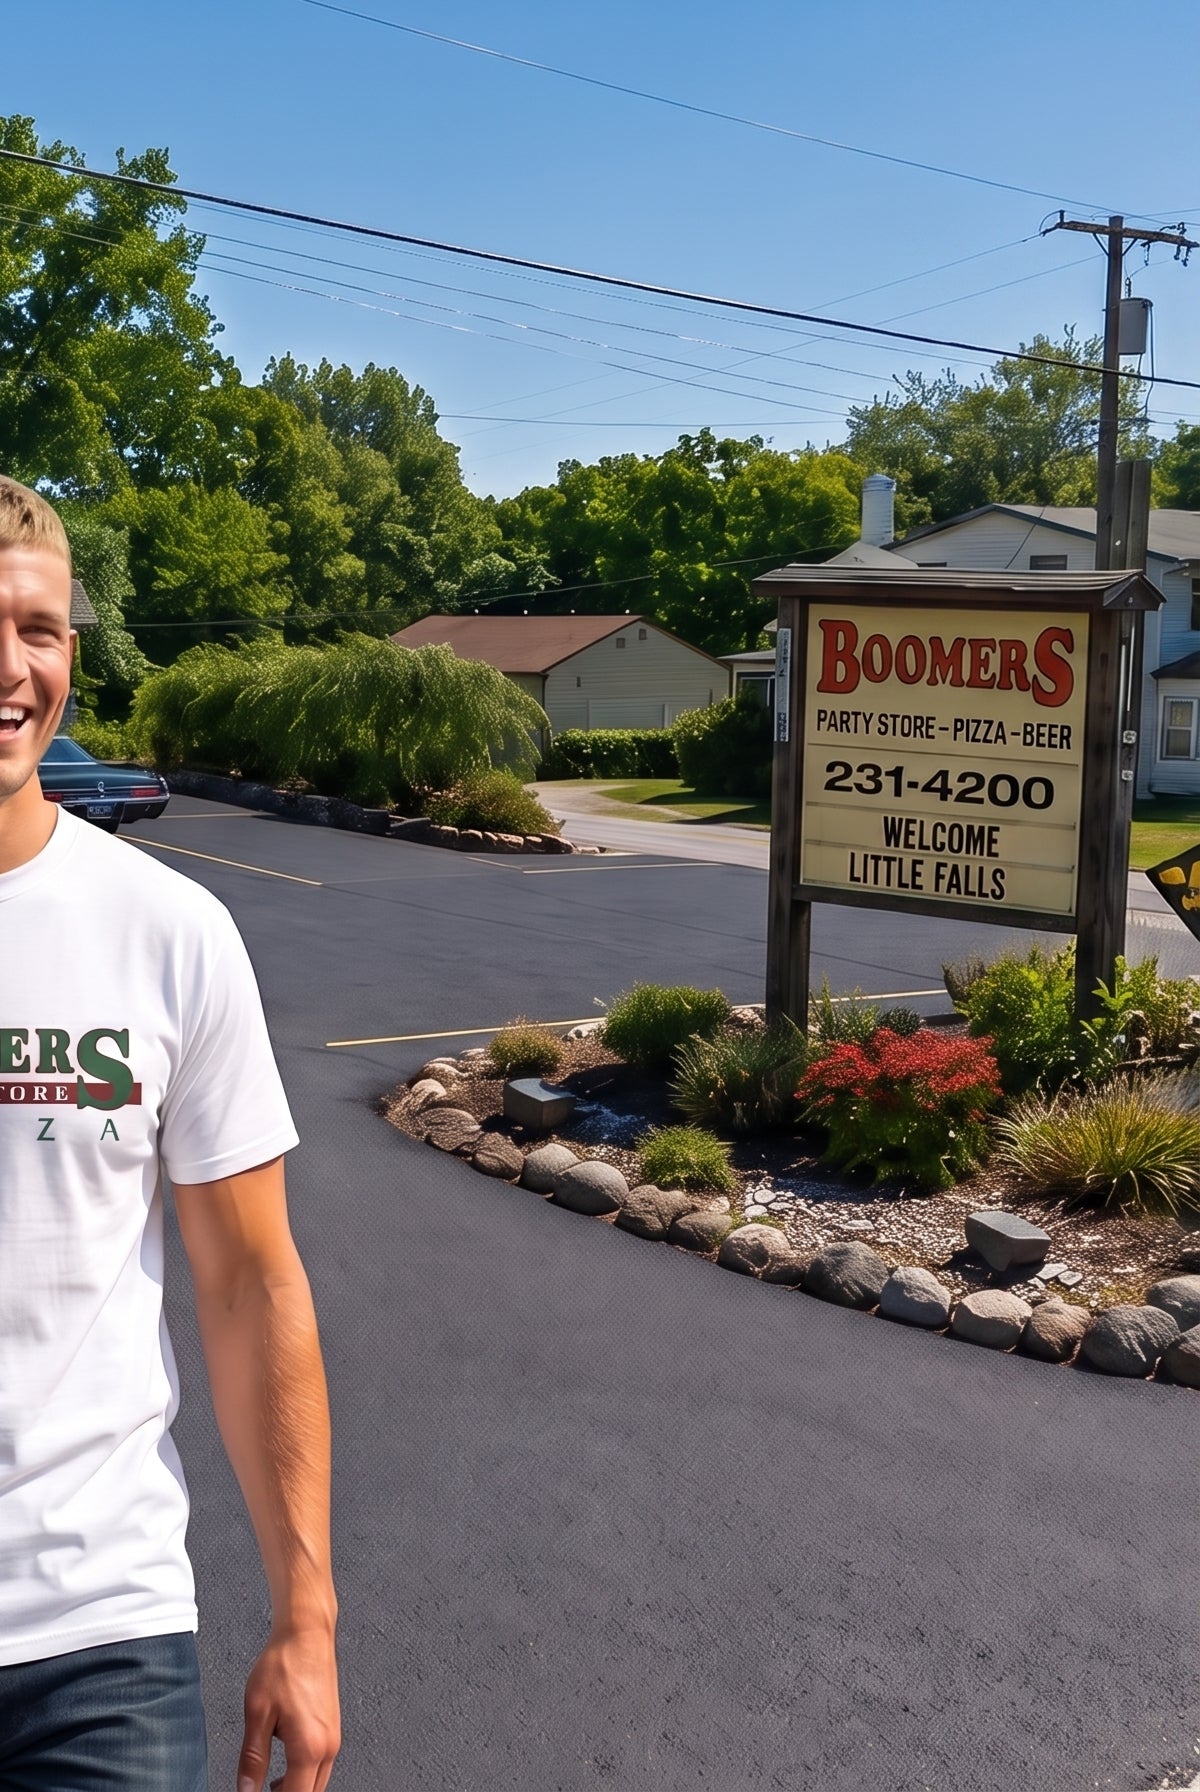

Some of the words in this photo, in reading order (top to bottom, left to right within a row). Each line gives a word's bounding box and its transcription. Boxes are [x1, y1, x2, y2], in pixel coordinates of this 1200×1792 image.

[816, 619, 1075, 708] BOOMERS
[817, 709, 874, 735] PARTY
[877, 713, 937, 740] STORE
[953, 718, 1007, 745] PIZZA
[1022, 722, 1072, 750] BEER
[824, 760, 1055, 810] 231-4200
[883, 815, 1000, 858] WELCOME
[849, 852, 924, 891] LITTLE
[934, 861, 1006, 901] FALLS
